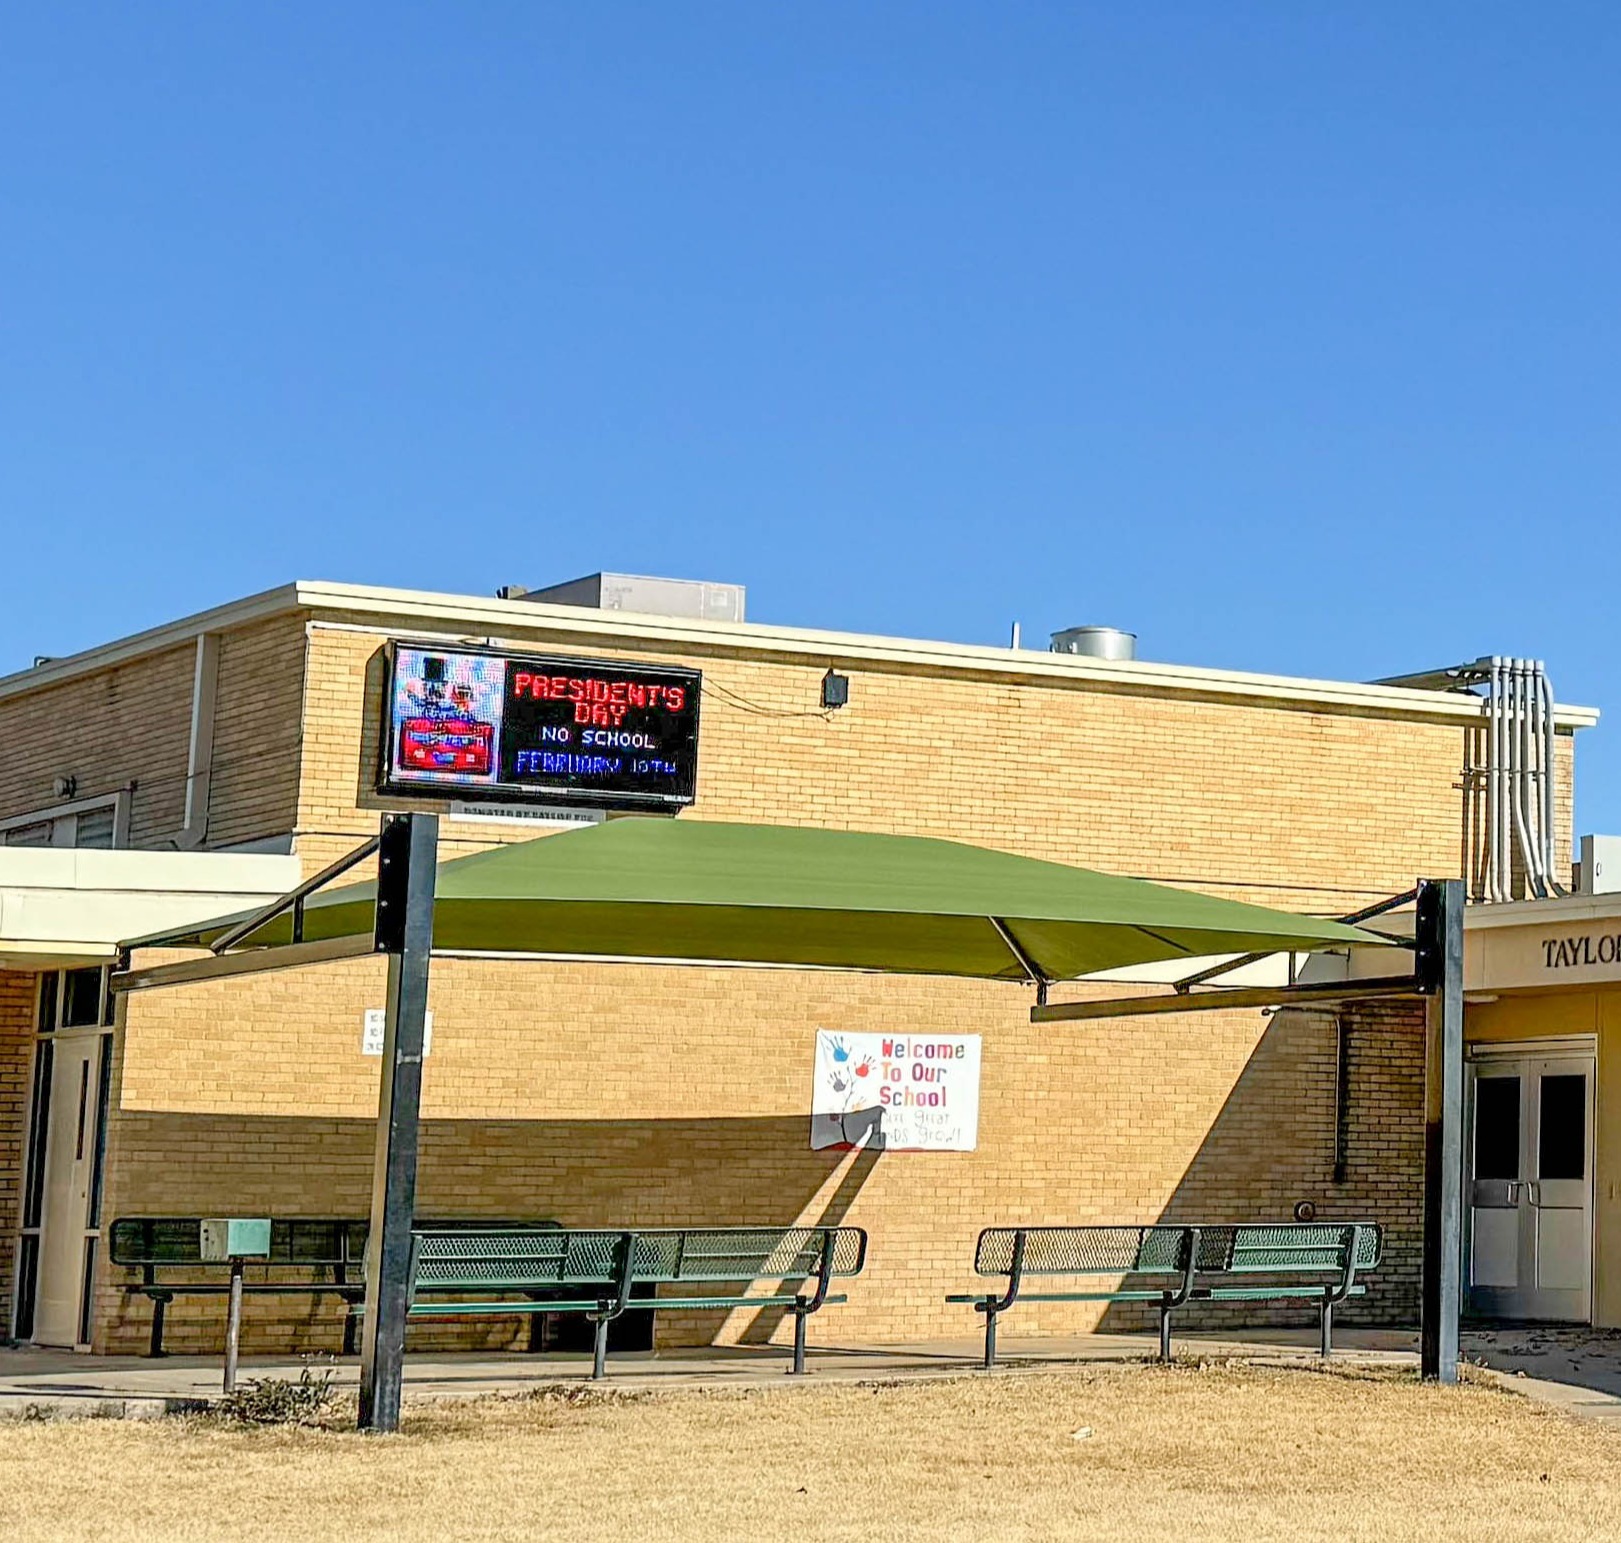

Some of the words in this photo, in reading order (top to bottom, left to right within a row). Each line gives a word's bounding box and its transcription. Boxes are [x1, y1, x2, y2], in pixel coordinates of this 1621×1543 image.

[514, 672, 686, 712] PRESIDENT'S
[574, 703, 628, 727] DAY
[541, 725, 570, 742] NO
[581, 729, 656, 749] SCHOOL
[516, 750, 622, 773] FEBRUARY
[881, 1037, 965, 1060] Welcome
[881, 1061, 902, 1083] To
[912, 1062, 948, 1083] Our
[879, 1085, 947, 1108] School
